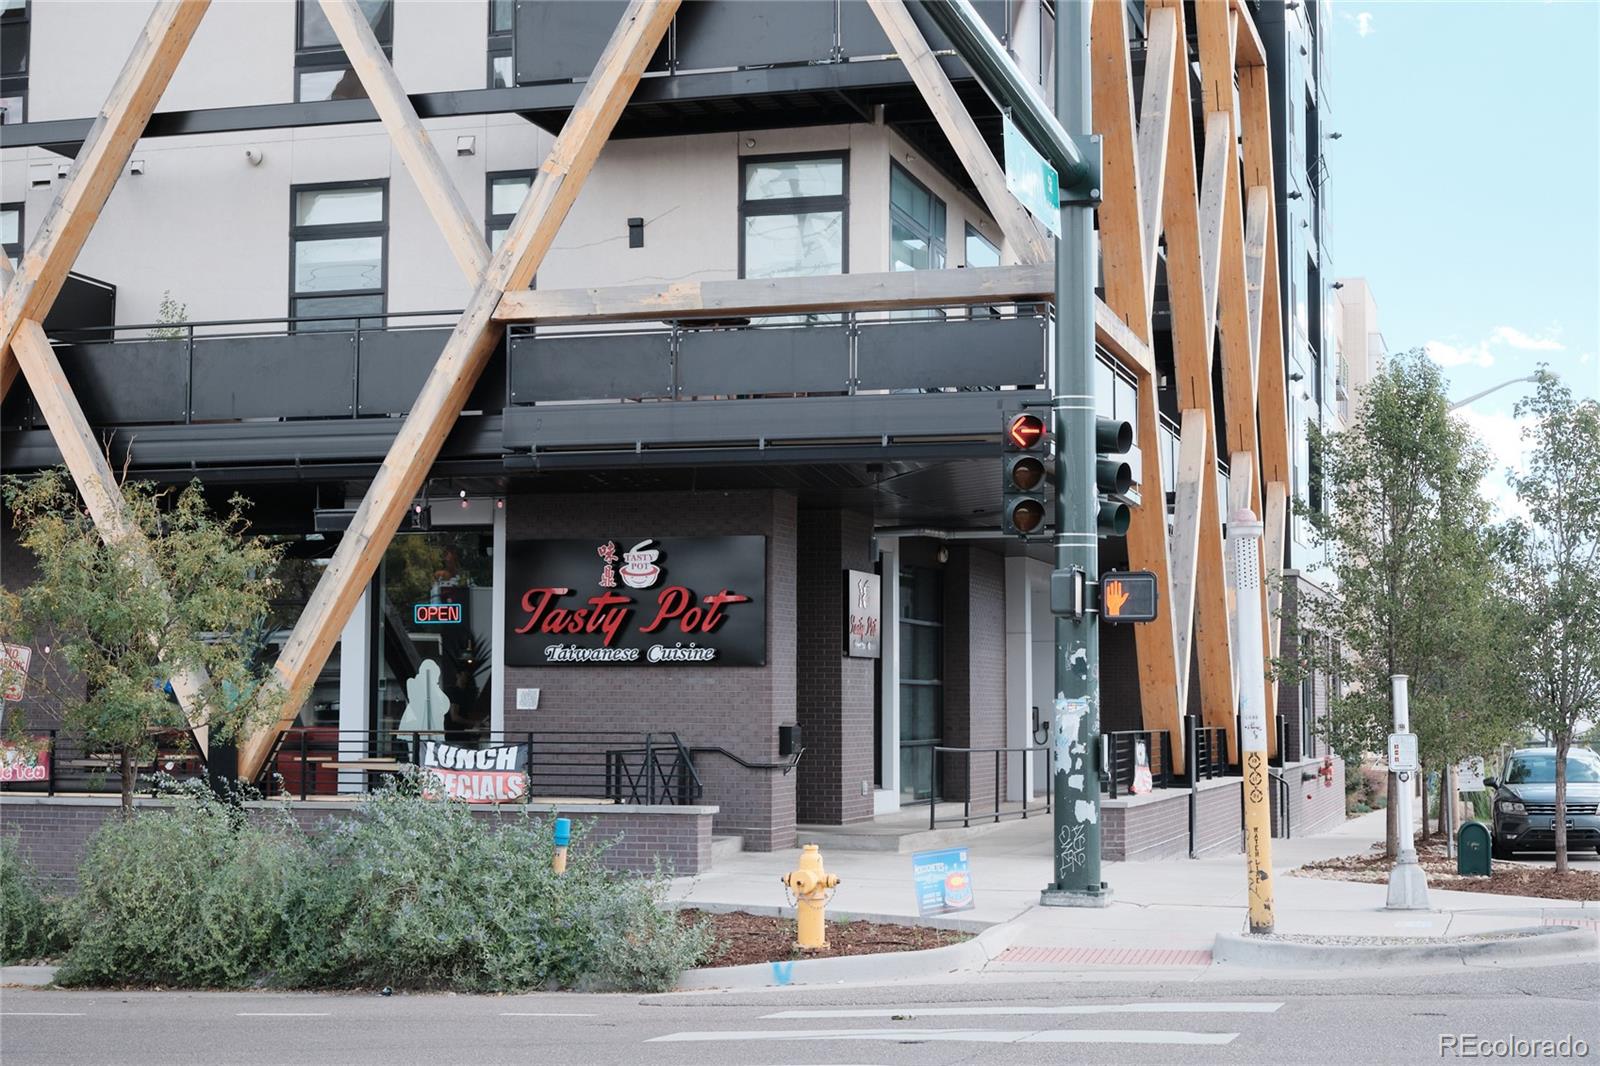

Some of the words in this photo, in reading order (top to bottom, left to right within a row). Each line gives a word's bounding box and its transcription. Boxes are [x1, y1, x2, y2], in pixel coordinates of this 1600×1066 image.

[625, 553, 653, 561] TASTY
[631, 562, 649, 570] POT
[417, 606, 459, 621] OPEN
[515, 587, 631, 646] Tasty
[639, 586, 748, 633] Pot
[544, 644, 640, 662] Taiwanese
[646, 642, 715, 662] Cuisine
[424, 741, 518, 770] LUNCH
[421, 771, 523, 800] ECIALS
